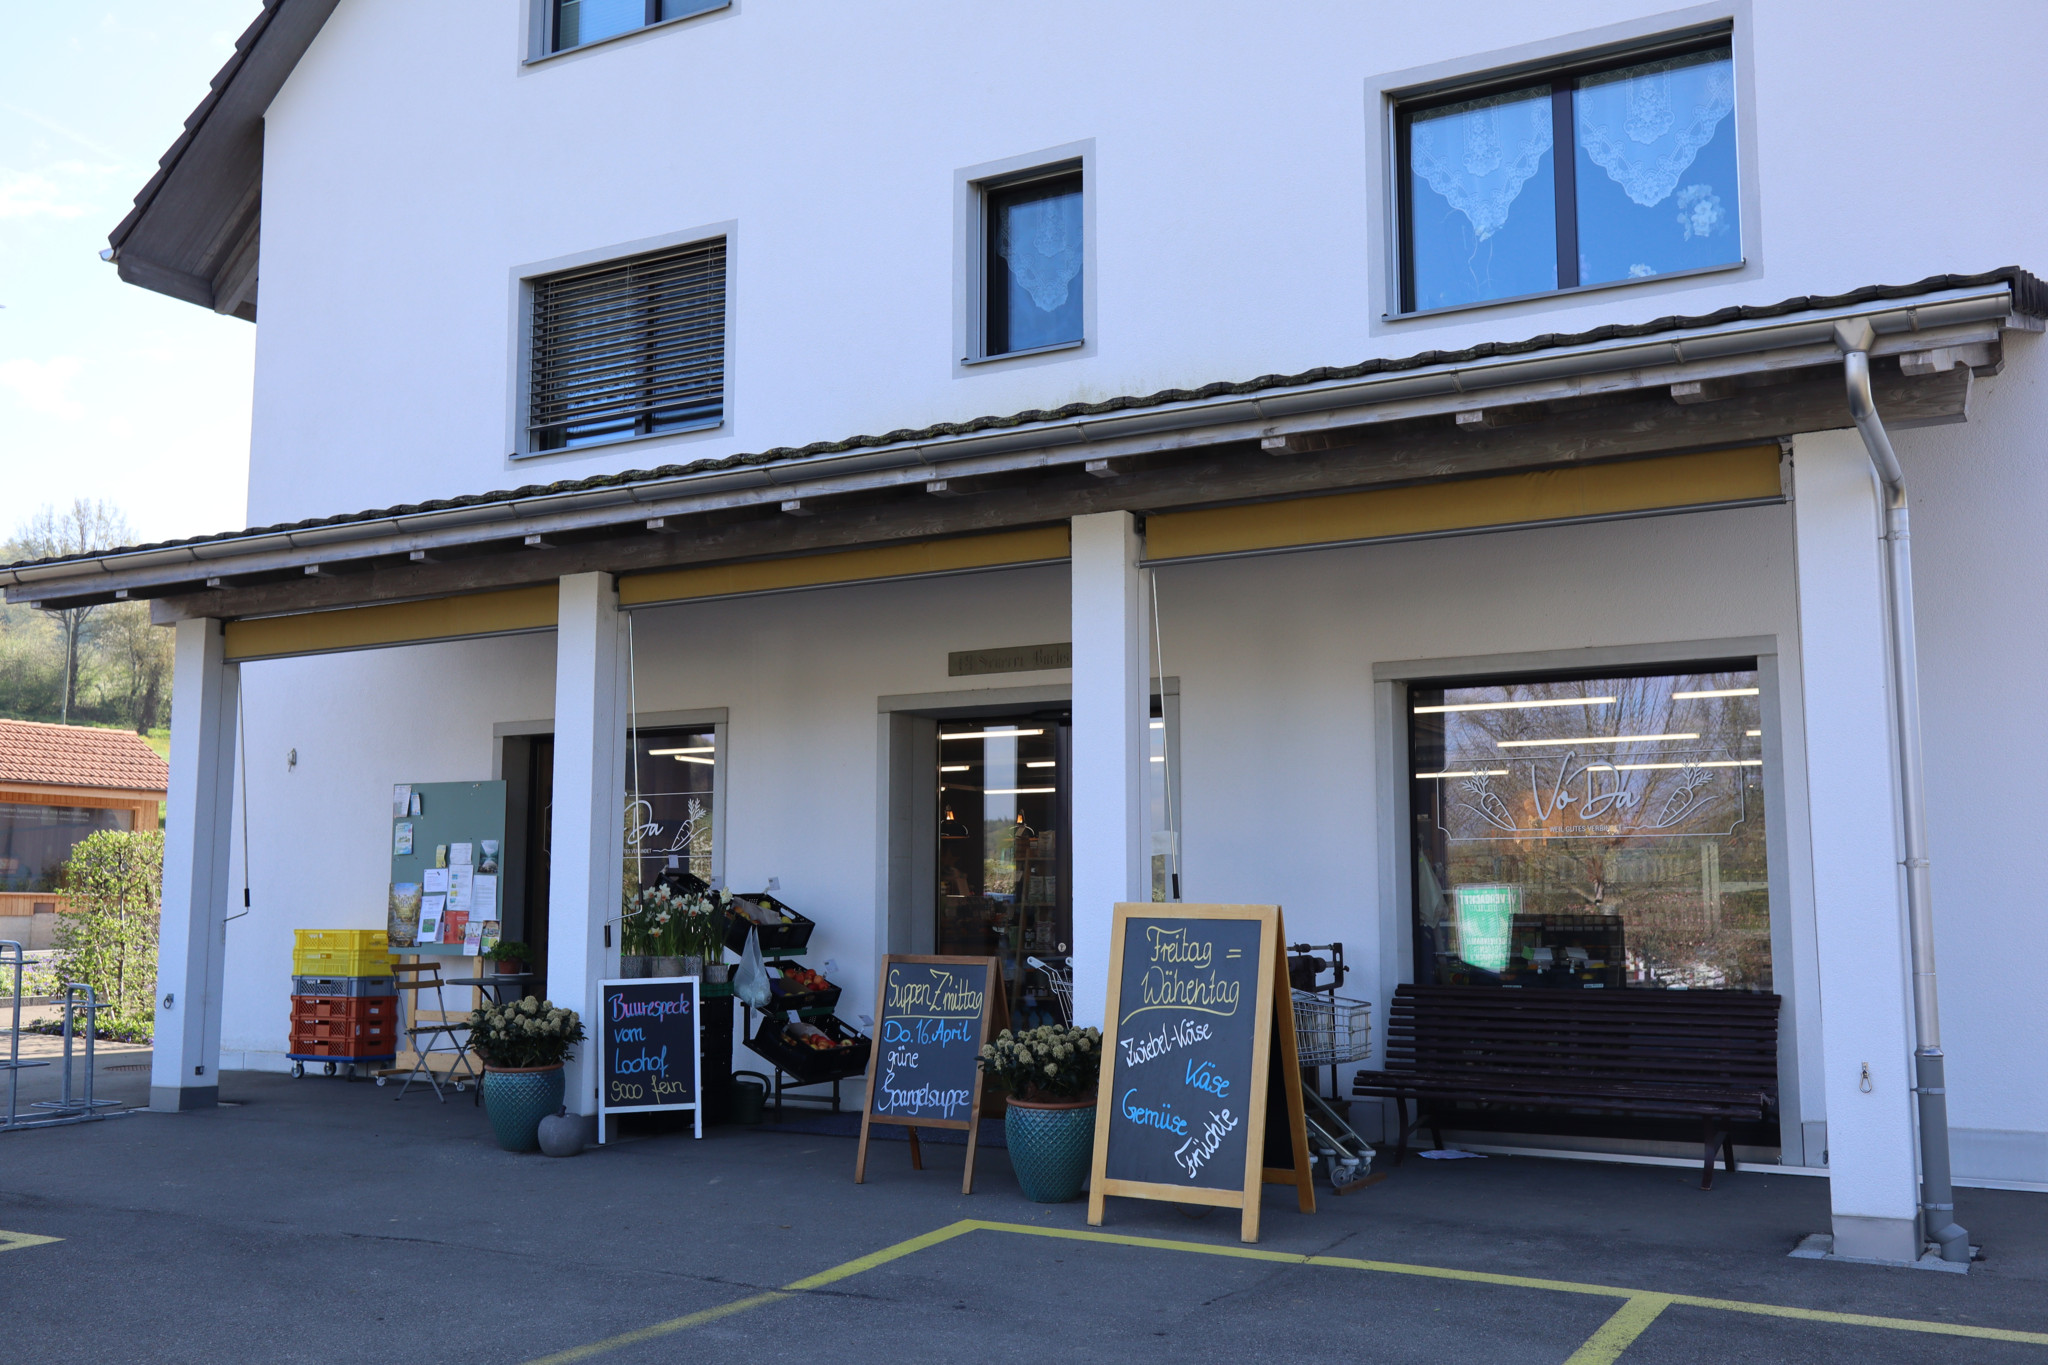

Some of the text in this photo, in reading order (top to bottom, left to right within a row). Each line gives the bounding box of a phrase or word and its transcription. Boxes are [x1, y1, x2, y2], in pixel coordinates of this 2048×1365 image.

[1146, 925, 1213, 969] Freitag
[1141, 965, 1240, 1012] Wähentag
[614, 1026, 647, 1043] vom
[884, 1020, 914, 1043] Do.
[931, 1018, 972, 1048] April
[615, 1045, 668, 1079] Loohof
[887, 1045, 919, 1073] grüne
[1184, 1058, 1230, 1098] Käse
[651, 1074, 687, 1104] fein
[877, 1072, 970, 1119] Spargelsuppe
[1122, 1087, 1189, 1136] Gemüse
[1174, 1107, 1239, 1179] Früchte
